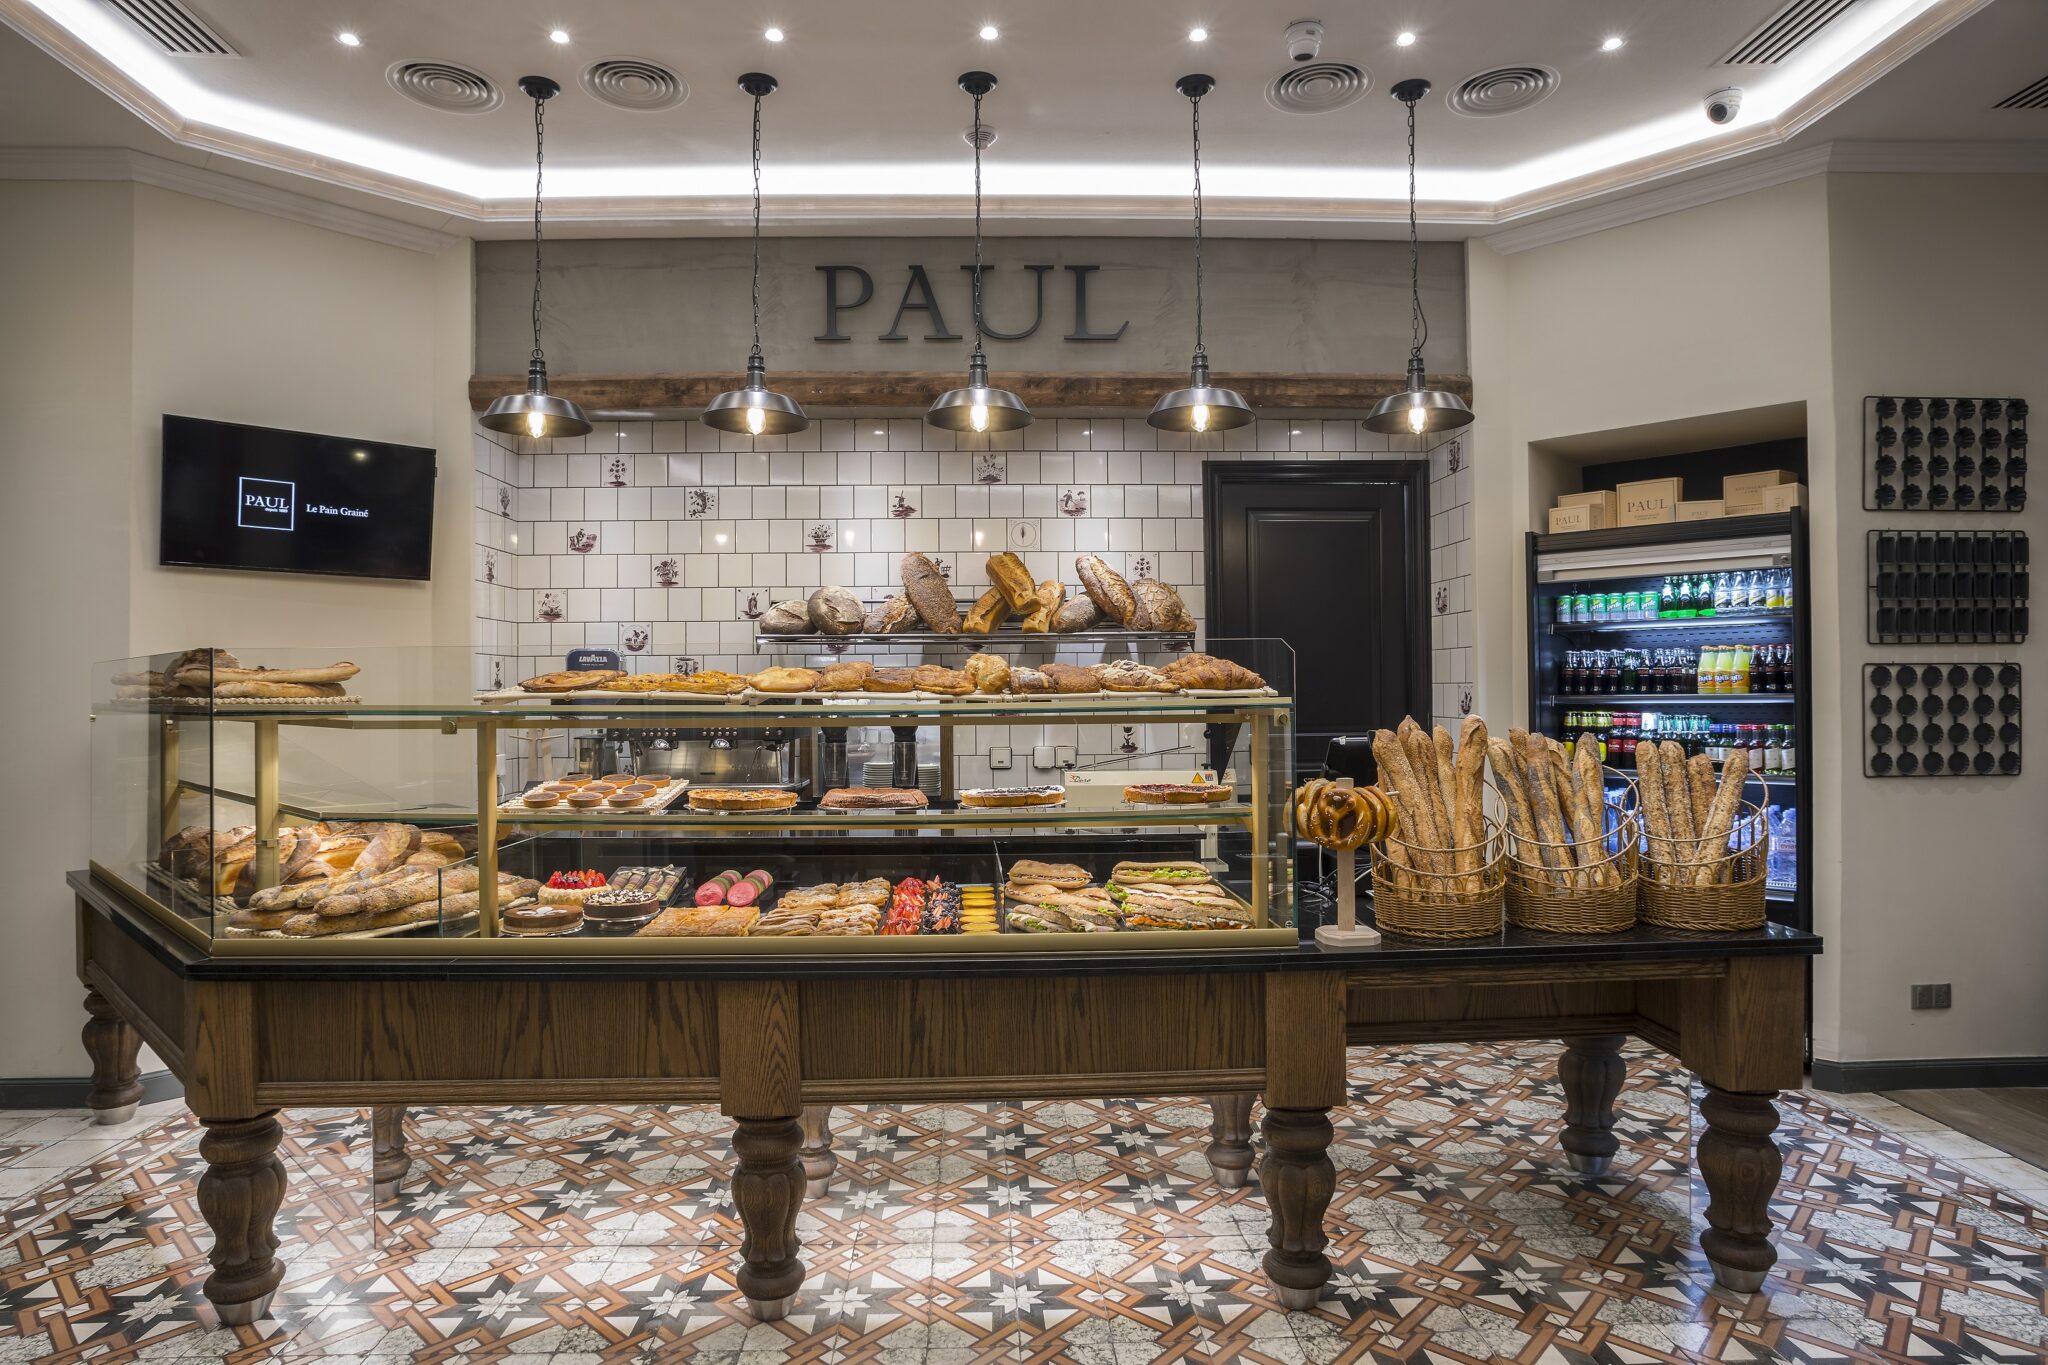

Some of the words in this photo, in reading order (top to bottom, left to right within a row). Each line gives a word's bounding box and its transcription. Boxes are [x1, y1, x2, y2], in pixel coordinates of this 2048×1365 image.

[814, 264, 1130, 341] PAUL
[245, 494, 290, 509] PAUL
[1627, 499, 1668, 512] PAUL
[306, 503, 318, 513] Le
[319, 504, 339, 515] Pain
[340, 507, 369, 518] Grainé
[1555, 514, 1583, 526] PAUL
[579, 654, 608, 662] LAVAZZA
